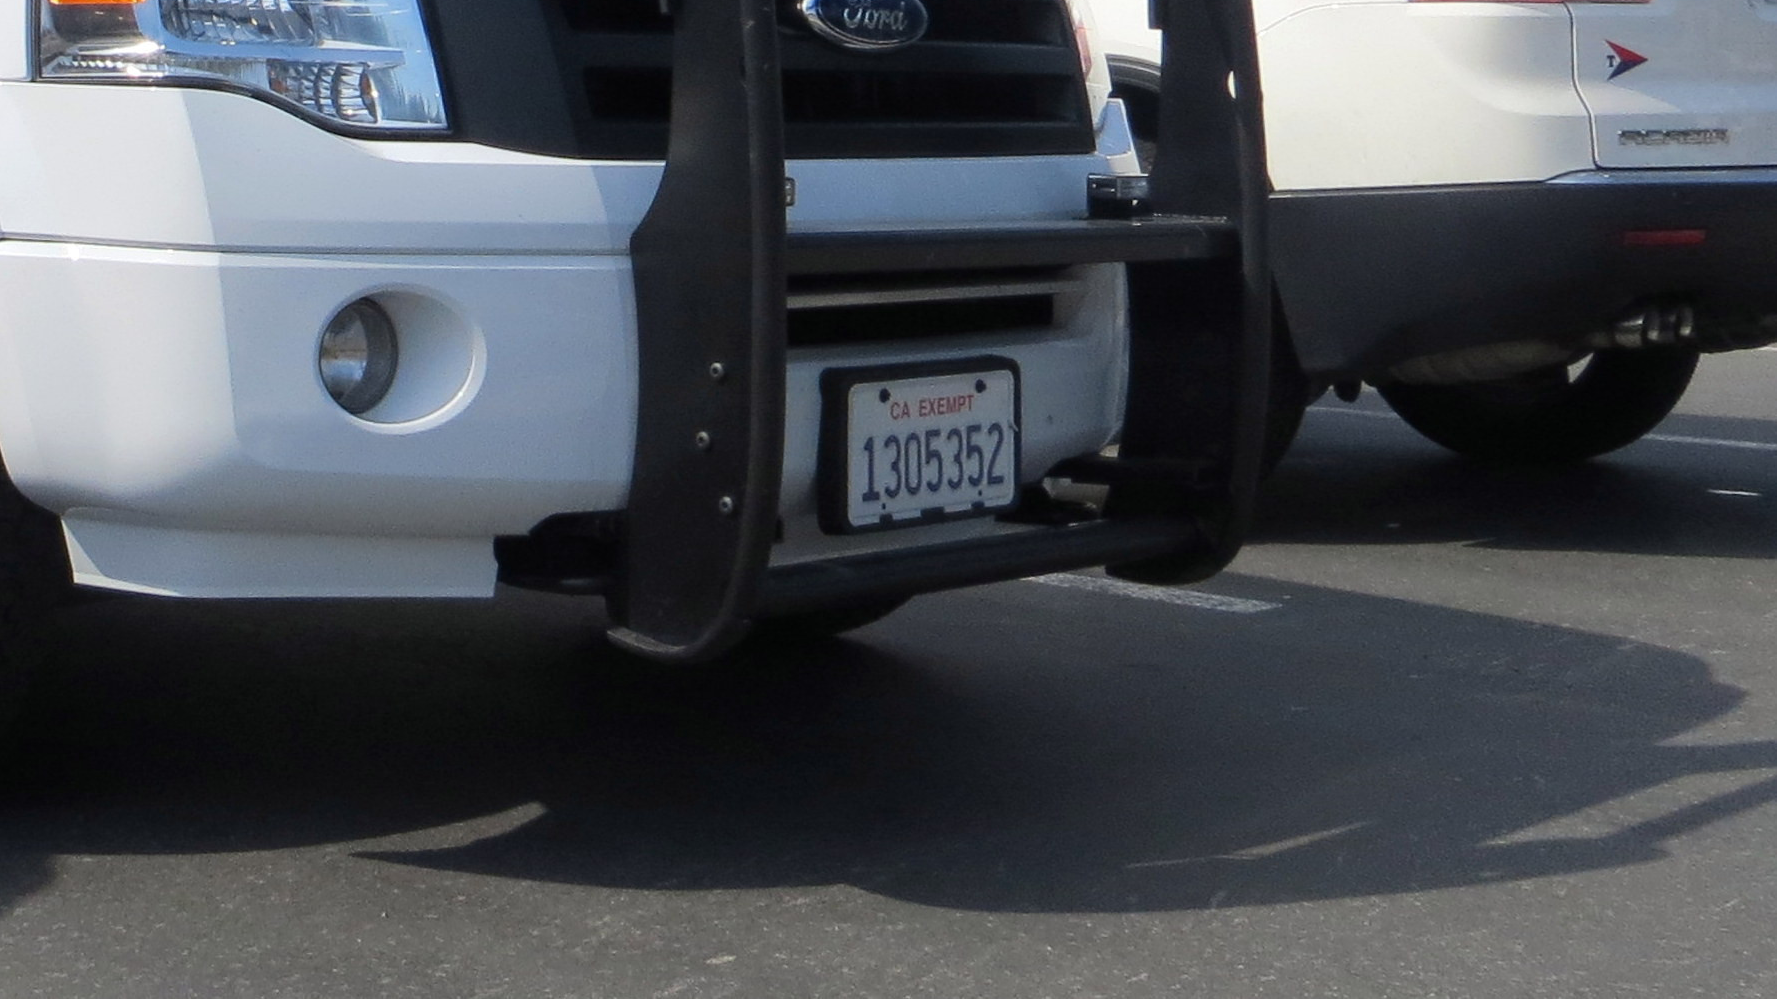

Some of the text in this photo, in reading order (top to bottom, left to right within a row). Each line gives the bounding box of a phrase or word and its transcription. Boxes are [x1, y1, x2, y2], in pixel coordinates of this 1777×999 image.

[890, 394, 975, 420] CA EXEMPT
[861, 422, 1005, 502] 1305352
